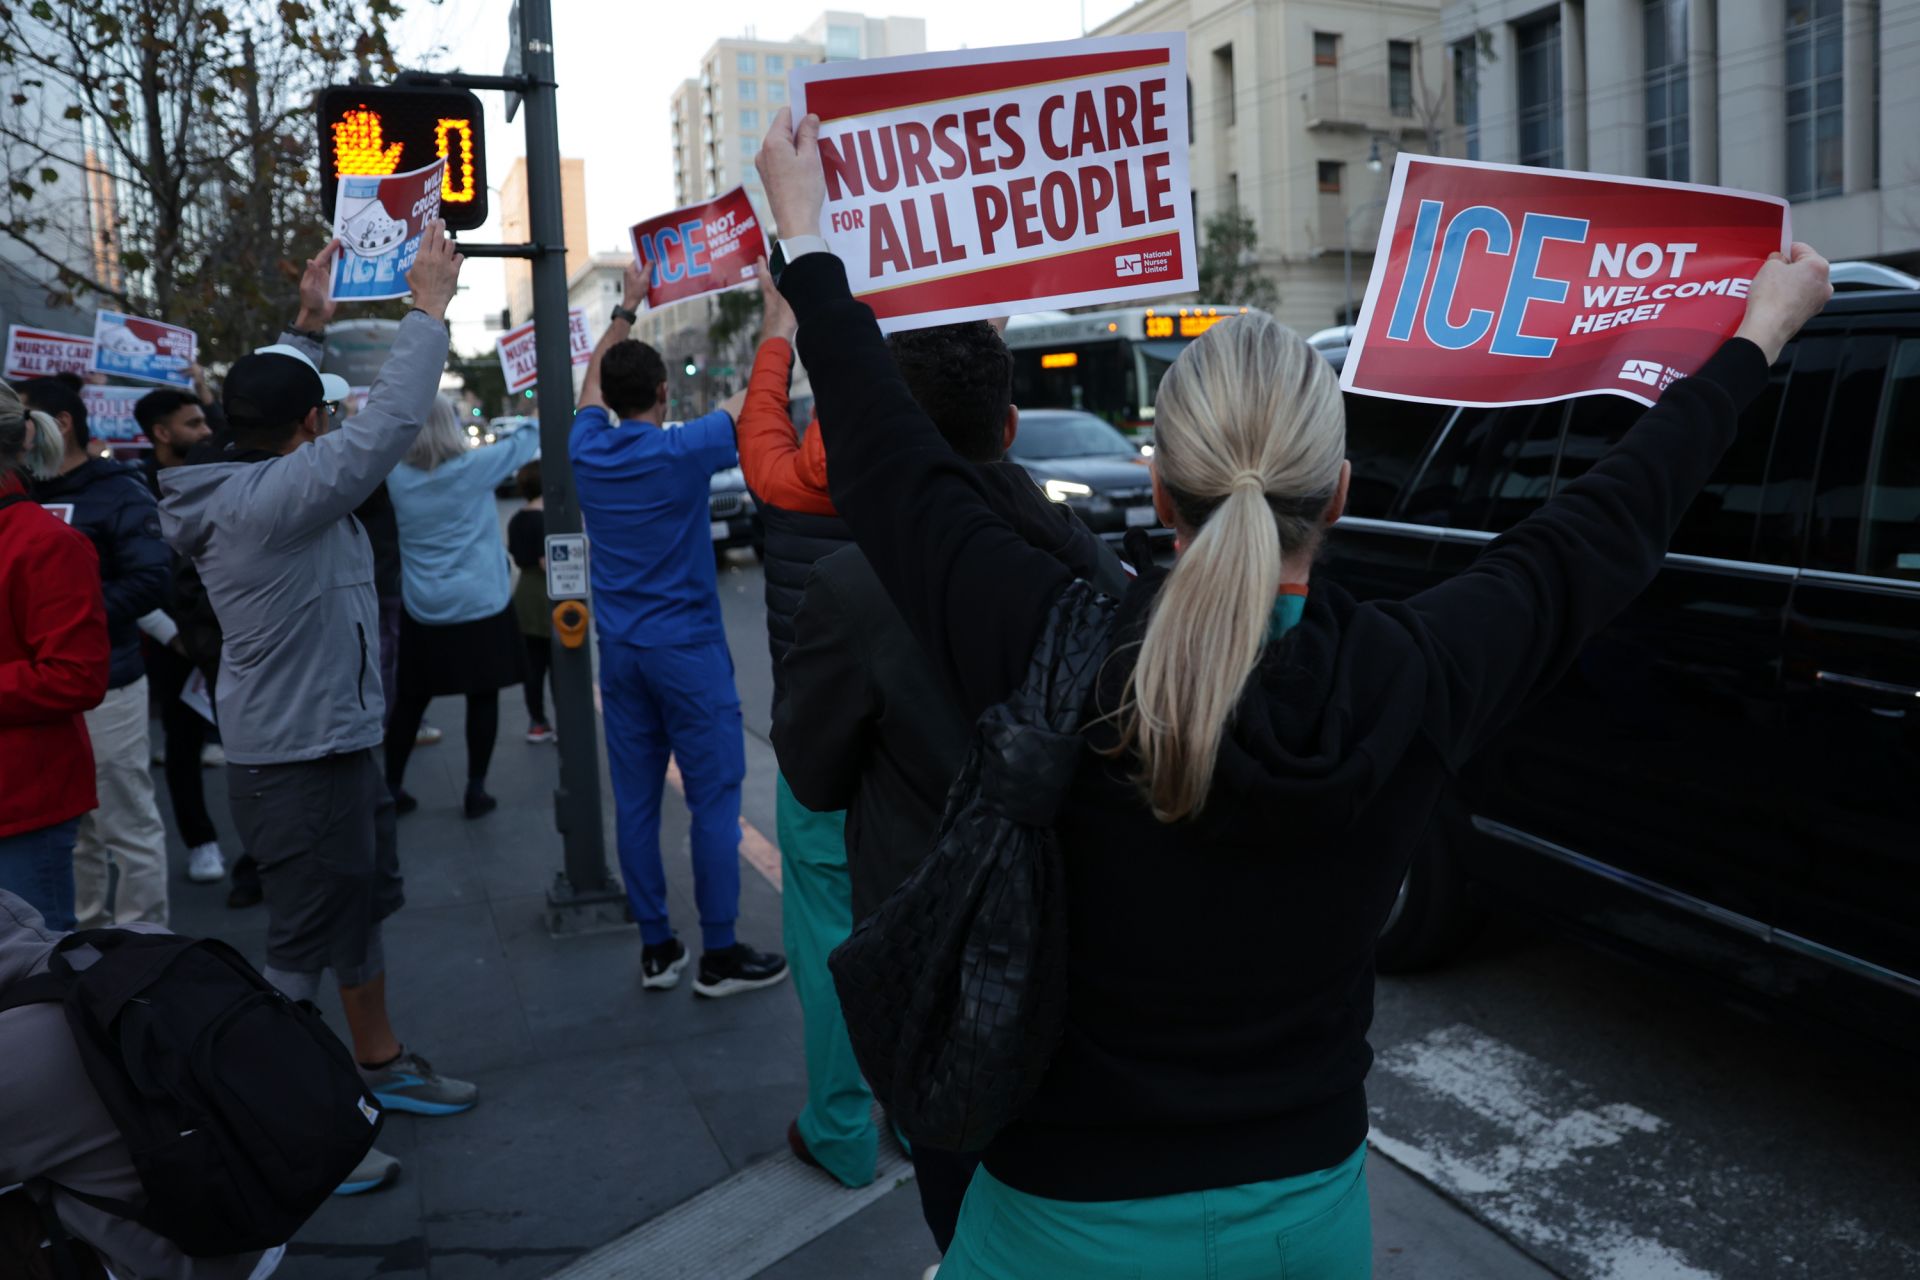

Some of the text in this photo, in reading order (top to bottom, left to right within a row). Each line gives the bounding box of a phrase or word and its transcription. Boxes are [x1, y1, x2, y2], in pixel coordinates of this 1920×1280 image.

[817, 78, 1168, 201] NURSES CARE
[434, 118, 475, 202] 0
[705, 210, 735, 237] NOT
[832, 152, 1175, 278] FOR ALL PEOPLE
[708, 216, 756, 248] WELCOME
[342, 248, 395, 284] ICE
[640, 218, 711, 289] ICE
[1143, 249, 1173, 259] National
[1144, 259, 1168, 267] Nurses
[1145, 264, 1168, 274] United
[1588, 242, 1698, 279] NOT
[1386, 199, 1590, 358] ICE
[1582, 277, 1753, 310] WELCOME
[1569, 303, 1665, 336] HERE!
[15, 341, 92, 359] NURSES CAR
[19, 356, 88, 374] ALL PEOPL
[506, 336, 535, 361] NURS
